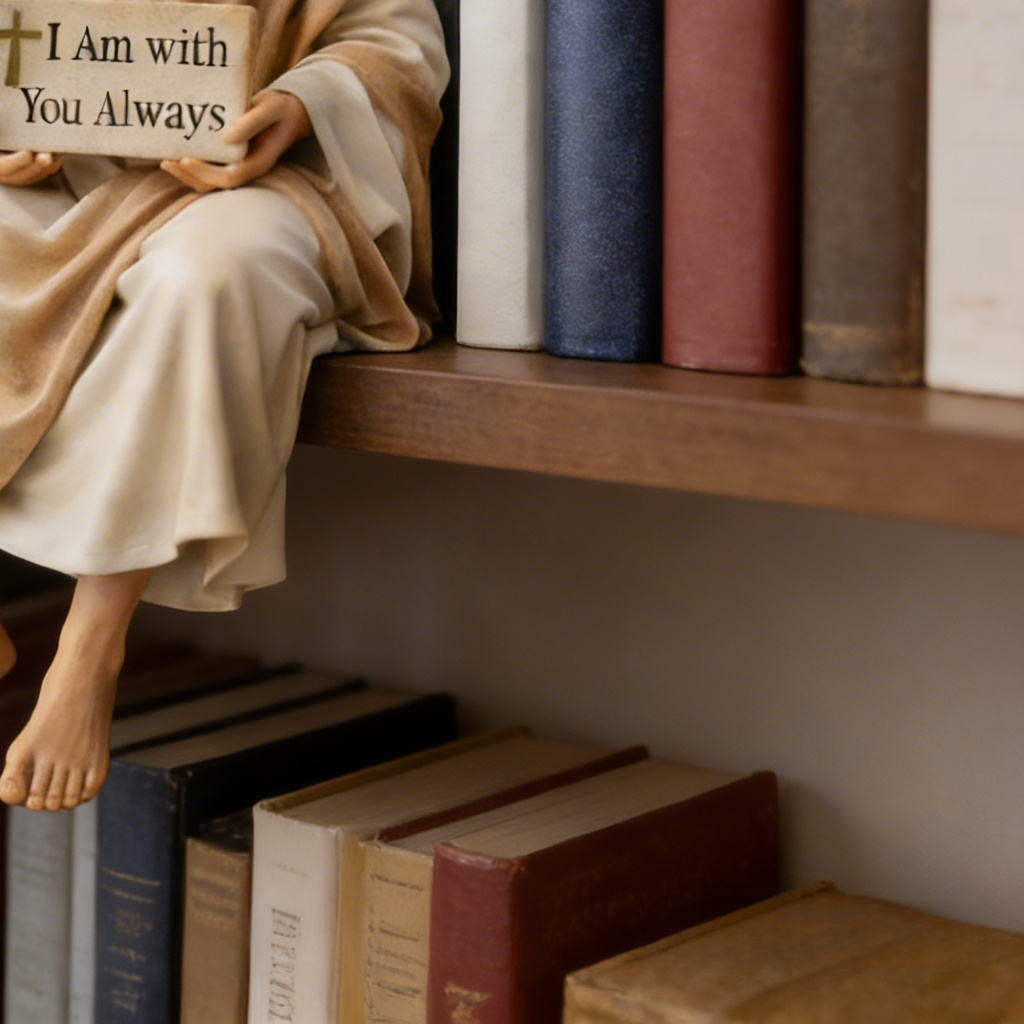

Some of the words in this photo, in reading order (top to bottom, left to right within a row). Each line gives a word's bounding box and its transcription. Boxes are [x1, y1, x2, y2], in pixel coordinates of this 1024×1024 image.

[46, 22, 61, 61] I
[72, 25, 134, 64] Am
[145, 26, 228, 68] with
[19, 87, 82, 126] You
[93, 89, 226, 141] Always
